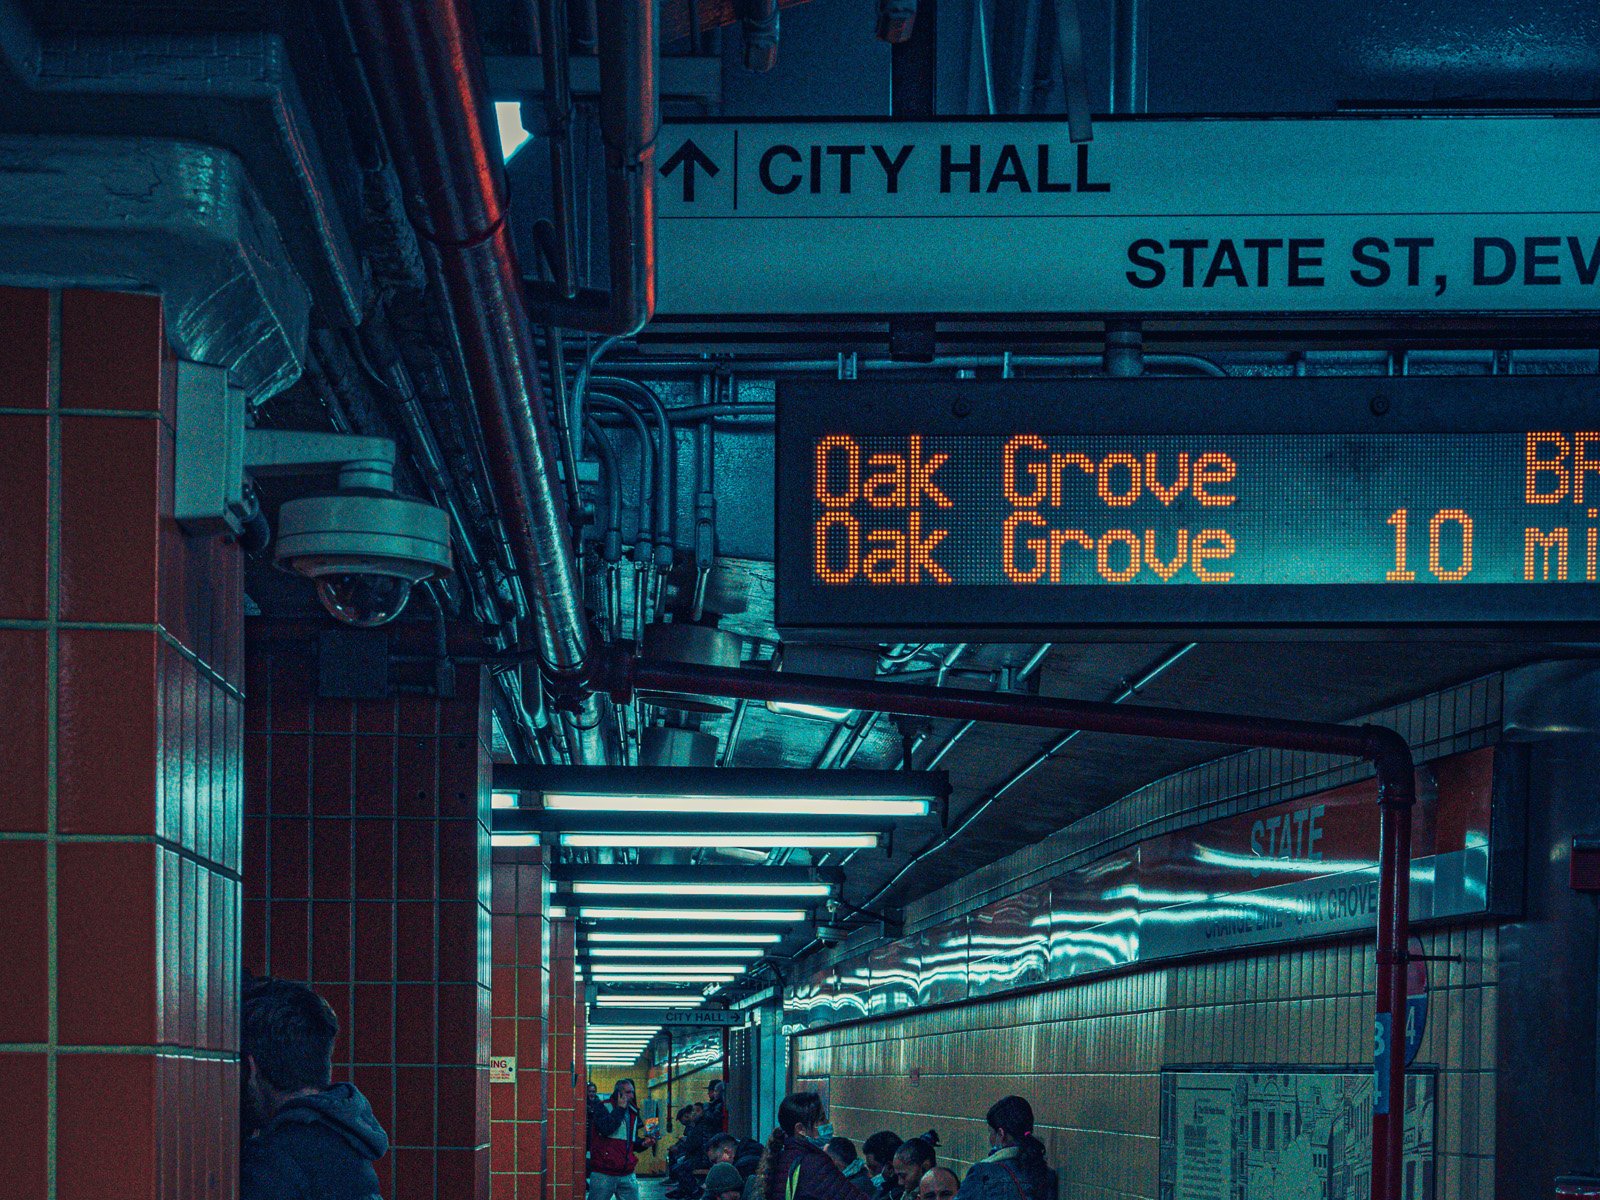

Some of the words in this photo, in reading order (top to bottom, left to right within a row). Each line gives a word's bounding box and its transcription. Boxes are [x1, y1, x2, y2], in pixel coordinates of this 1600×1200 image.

[759, 144, 915, 195] CITY
[940, 144, 1111, 194] HALL
[1126, 238, 1324, 289] STATE
[1350, 237, 1447, 297] ST,
[815, 436, 952, 507] Oak
[1003, 436, 1236, 507] Grove
[815, 512, 952, 583] Oak
[1003, 512, 1236, 583] Grove
[1386, 509, 1473, 581] 10
[1250, 803, 1325, 878] STATE
[1327, 883, 1378, 921] GROVE
[665, 1012, 692, 1021] CITY
[695, 1012, 724, 1022] HALL
